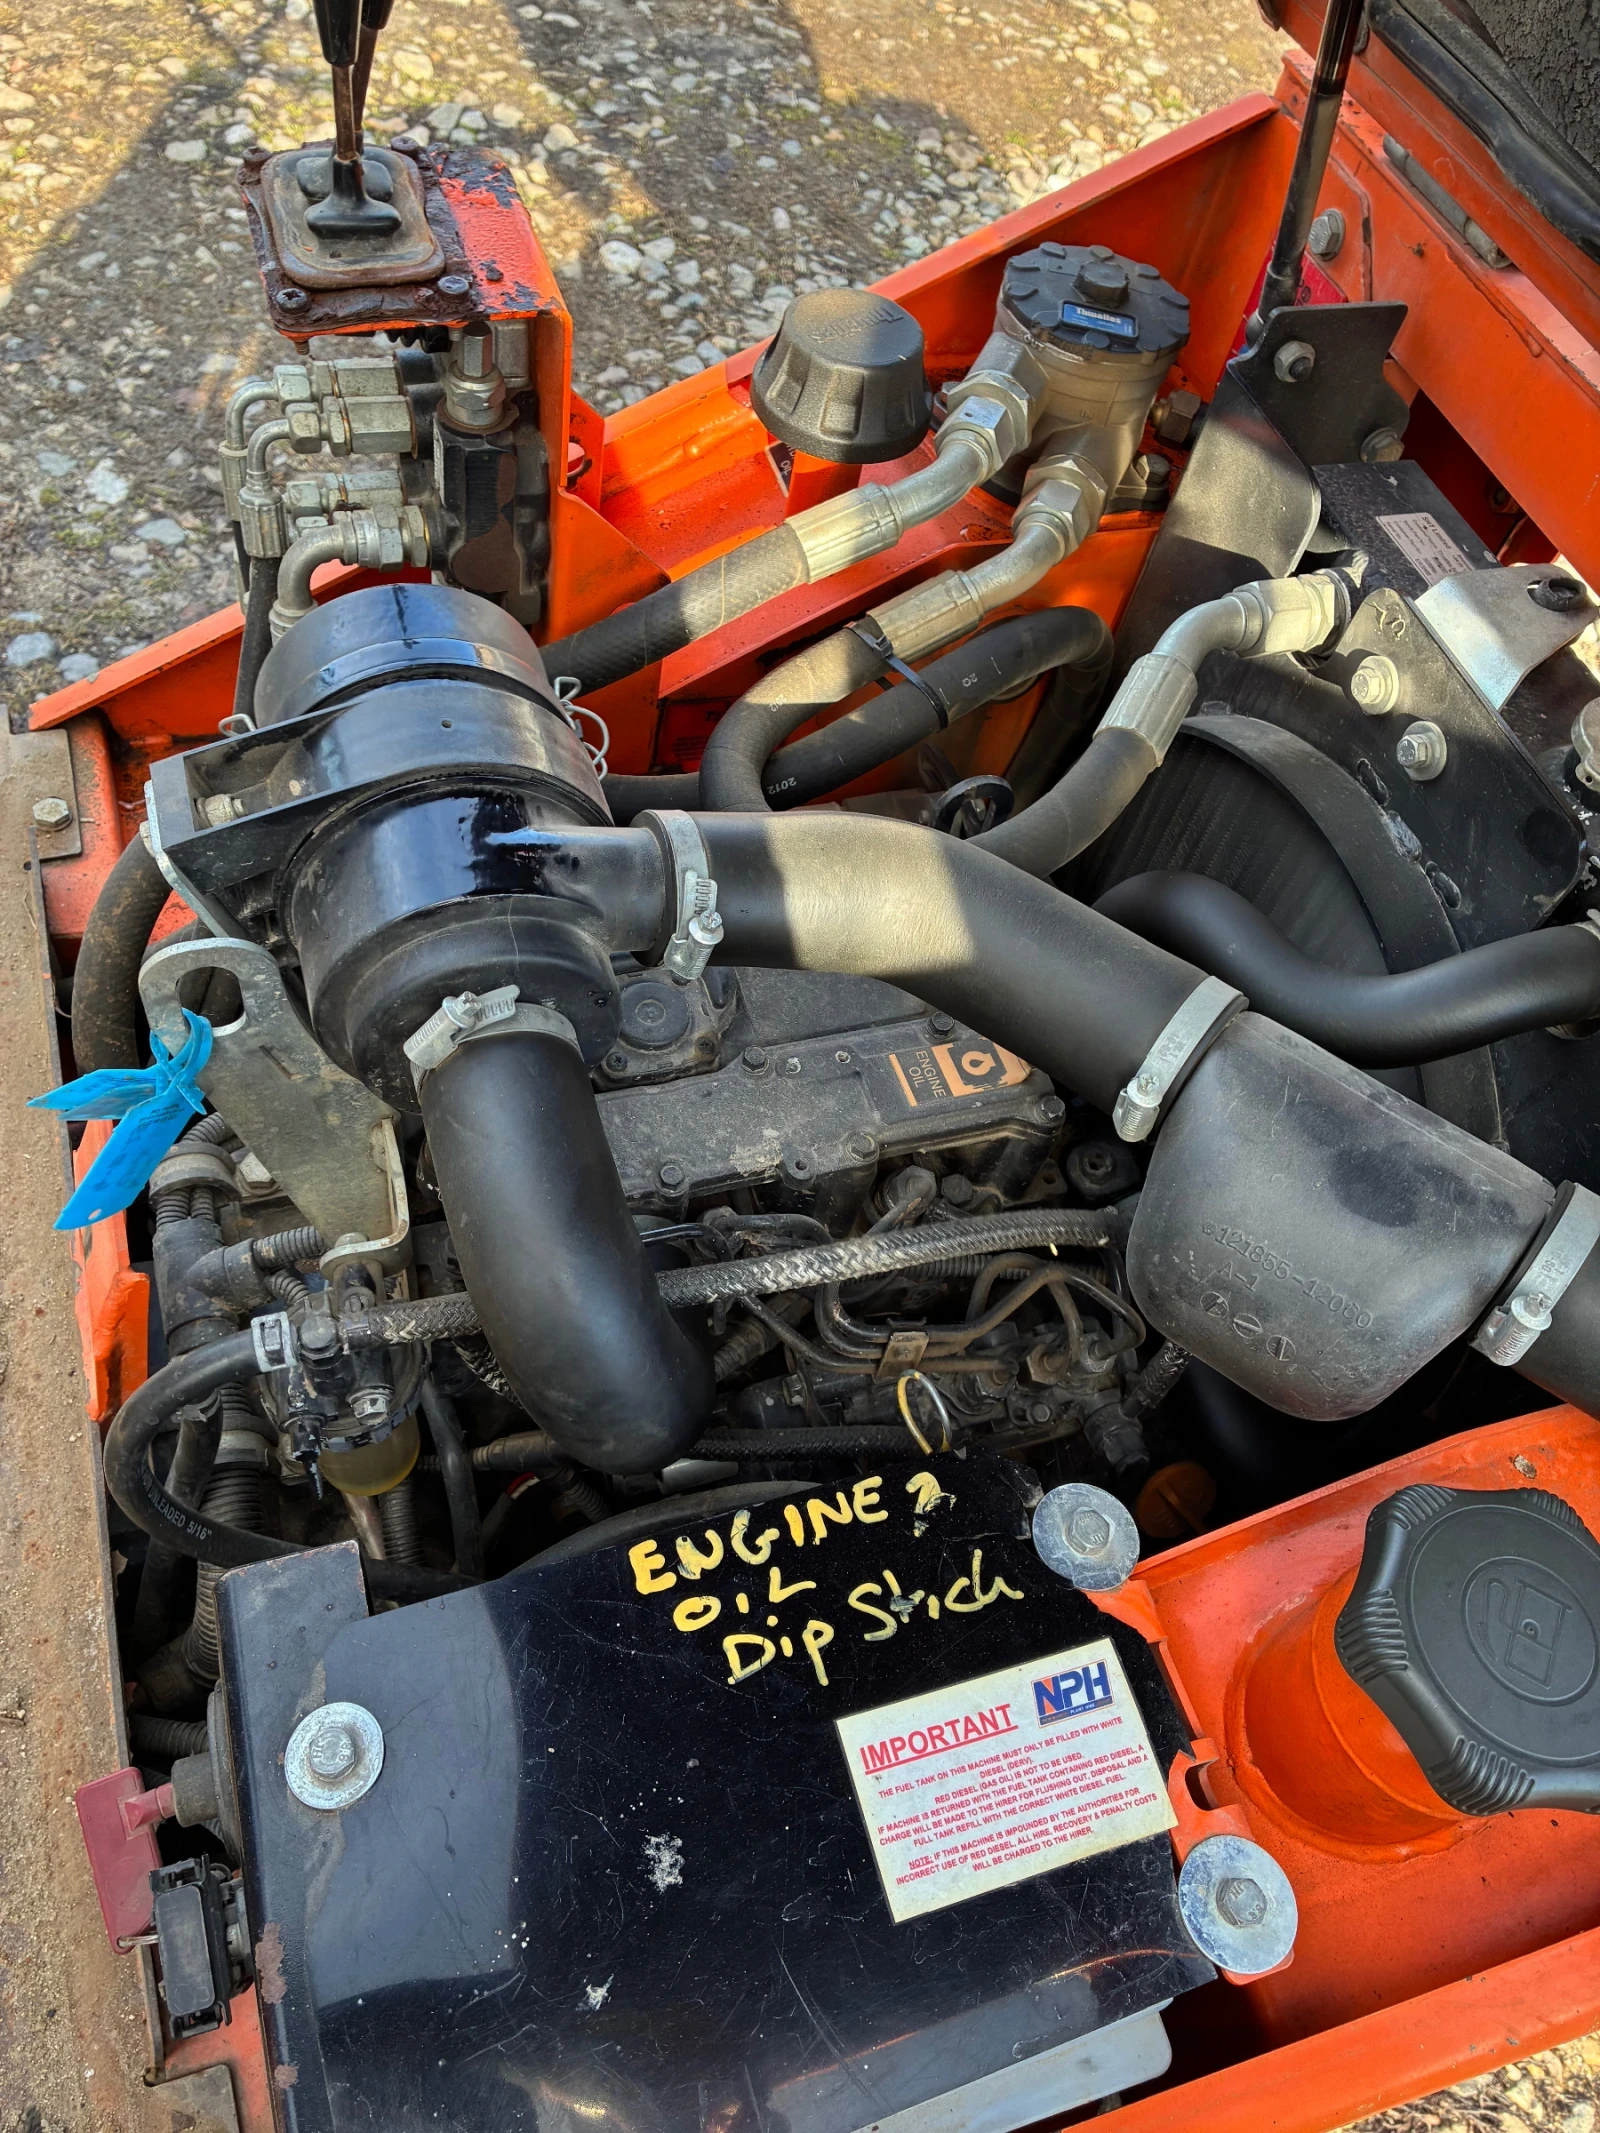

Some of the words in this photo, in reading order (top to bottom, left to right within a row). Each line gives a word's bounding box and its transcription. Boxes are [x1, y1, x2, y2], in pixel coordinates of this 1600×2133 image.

[769, 692, 788, 712] 2012
[767, 777, 798, 795] 2012
[908, 1066, 921, 1089] OIL
[916, 1050, 947, 1098] ENGINE
[1217, 1261, 1261, 1292] A-1
[147, 1488, 186, 1528] UNLEADED
[186, 1523, 213, 1541] 5/16"
[628, 1475, 889, 1595] ENGINE
[723, 1615, 835, 1687] Dip
[1033, 1661, 1112, 1717] NPH
[860, 1703, 1014, 1771] IMPORTANT
[878, 1787, 894, 1798] THE
[894, 1782, 915, 1793] FUEL
[915, 1774, 936, 1786] TANK
[937, 1771, 949, 1780] ON
[949, 1765, 967, 1776] THIS
[967, 1754, 1001, 1771] MACHINE
[1001, 1747, 1022, 1760] MUST
[1023, 1741, 1043, 1753] ONLY
[1044, 1737, 1055, 1747] BE
[1055, 1730, 1080, 1743] FILLED
[1080, 1723, 1099, 1735] WITH
[1099, 1716, 1123, 1729] WHITE
[877, 1826, 884, 1835] IF
[885, 1814, 921, 1832] MACHINE
[921, 1811, 929, 1820] IS
[930, 1798, 971, 1817] RETURNED
[971, 1792, 991, 1804] WITH
[991, 1787, 1007, 1797] THE
[1007, 1781, 1027, 1793] FUEL
[1027, 1773, 1049, 1786] TANK
[1048, 1759, 1093, 1779] CONTAINING
[1093, 1754, 1109, 1765] RED
[1109, 1747, 1137, 1760] DIESEL,
[934, 1793, 950, 1804] RED
[951, 1785, 978, 1799] DIESEL
[979, 1778, 998, 1792] (GAS
[998, 1774, 1014, 1784] OIL)
[1013, 1770, 1022, 1779] IS
[1022, 1765, 1038, 1776] NOT
[1038, 1762, 1050, 1770] TO
[1050, 1758, 1061, 1767] BE
[979, 1765, 1006, 1778] DIESEL
[879, 1829, 912, 1846] CHARGE
[912, 1823, 932, 1835] WILL
[931, 1819, 943, 1829] BE
[943, 1811, 966, 1825] MADE
[966, 1808, 978, 1817] TO
[978, 1802, 994, 1813] THE
[994, 1795, 1018, 1808] HIRER
[1018, 1790, 1035, 1800] FOR
[1035, 1778, 1072, 1795] FLUSHING
[1090, 1761, 1126, 1778] DISPOSAL
[1127, 1755, 1142, 1766] AND
[908, 1855, 934, 1870] NOTE:
[933, 1851, 940, 1860] IF
[941, 1845, 959, 1857] THIS
[960, 1833, 995, 1852] MACHINE
[995, 1831, 1004, 1840] IS
[1004, 1816, 1048, 1837] IMPOUNDED
[1049, 1812, 1059, 1822] BY
[1060, 1807, 1076, 1818] THE
[1077, 1792, 1124, 1813] AUTHORITIES
[1124, 1787, 1140, 1798] FOR
[913, 1835, 933, 1847] FULL
[933, 1827, 955, 1840] TANK
[955, 1819, 982, 1833] REFILL
[982, 1812, 1002, 1824] WITH
[1002, 1807, 1018, 1817] THE
[1018, 1795, 1053, 1812] CORRECT
[1054, 1787, 1078, 1801] WHITE
[1078, 1779, 1105, 1793] DIESEL
[895, 1864, 939, 1885] INCORRECT
[941, 1858, 957, 1870] USE
[958, 1854, 968, 1864] OF
[969, 1849, 986, 1860] RED
[987, 1840, 1016, 1855] DIESEL,
[1017, 1834, 1032, 1845] ALL
[1052, 1814, 1092, 1833] RECOVERY
[1100, 1801, 1132, 1817] PENALTY
[1134, 1792, 1157, 1806] COSTS
[972, 1860, 992, 1872] WILL
[991, 1855, 1003, 1865] BE
[1004, 1843, 1041, 1861] CHARGED
[1041, 1839, 1053, 1848] TO
[1052, 1833, 1068, 1844] THE
